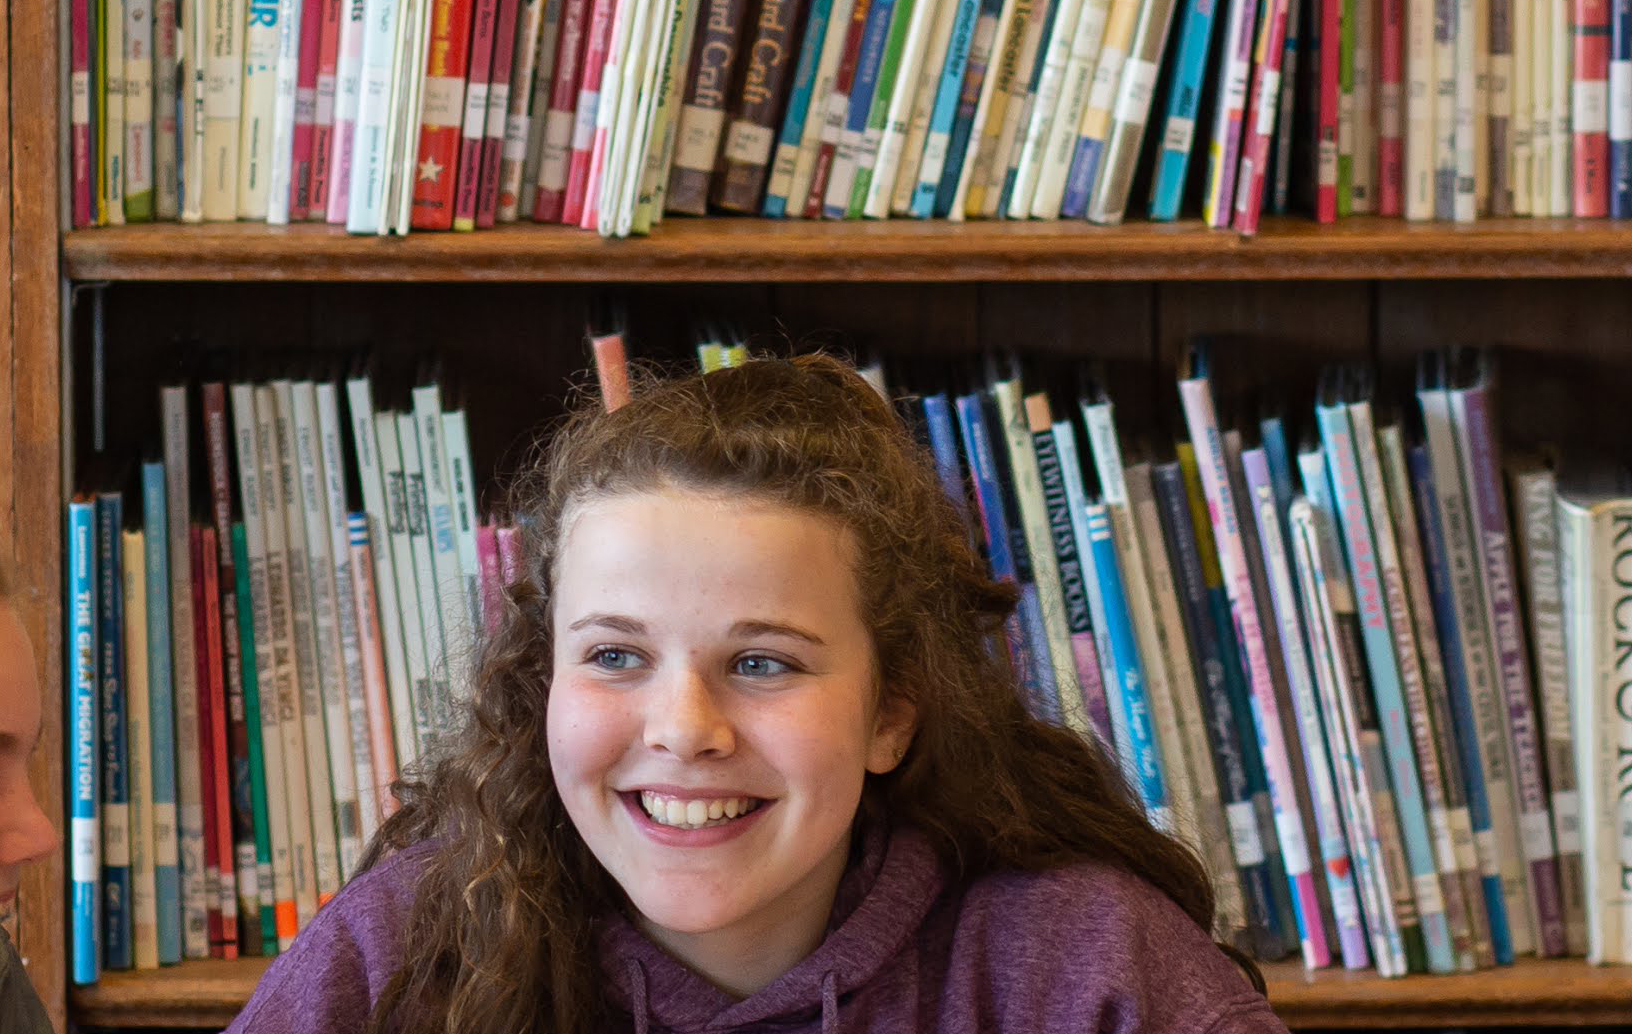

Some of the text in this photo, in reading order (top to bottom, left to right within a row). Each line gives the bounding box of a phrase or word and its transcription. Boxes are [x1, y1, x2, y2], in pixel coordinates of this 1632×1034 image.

[388, 470, 405, 535] Printing
[407, 471, 425, 536] Printing
[1034, 432, 1090, 631] EYEWITNESS BOOKS
[1332, 431, 1387, 629] PHOTOGRAPHY
[1525, 475, 1554, 542] SING
[1483, 530, 1517, 603] APPLE
[1530, 547, 1561, 601] FOR
[76, 590, 92, 626] THE
[1497, 611, 1524, 652] FOR
[76, 631, 94, 691] GREAT
[1504, 663, 1529, 708] THE
[77, 694, 95, 801] MIGRATION
